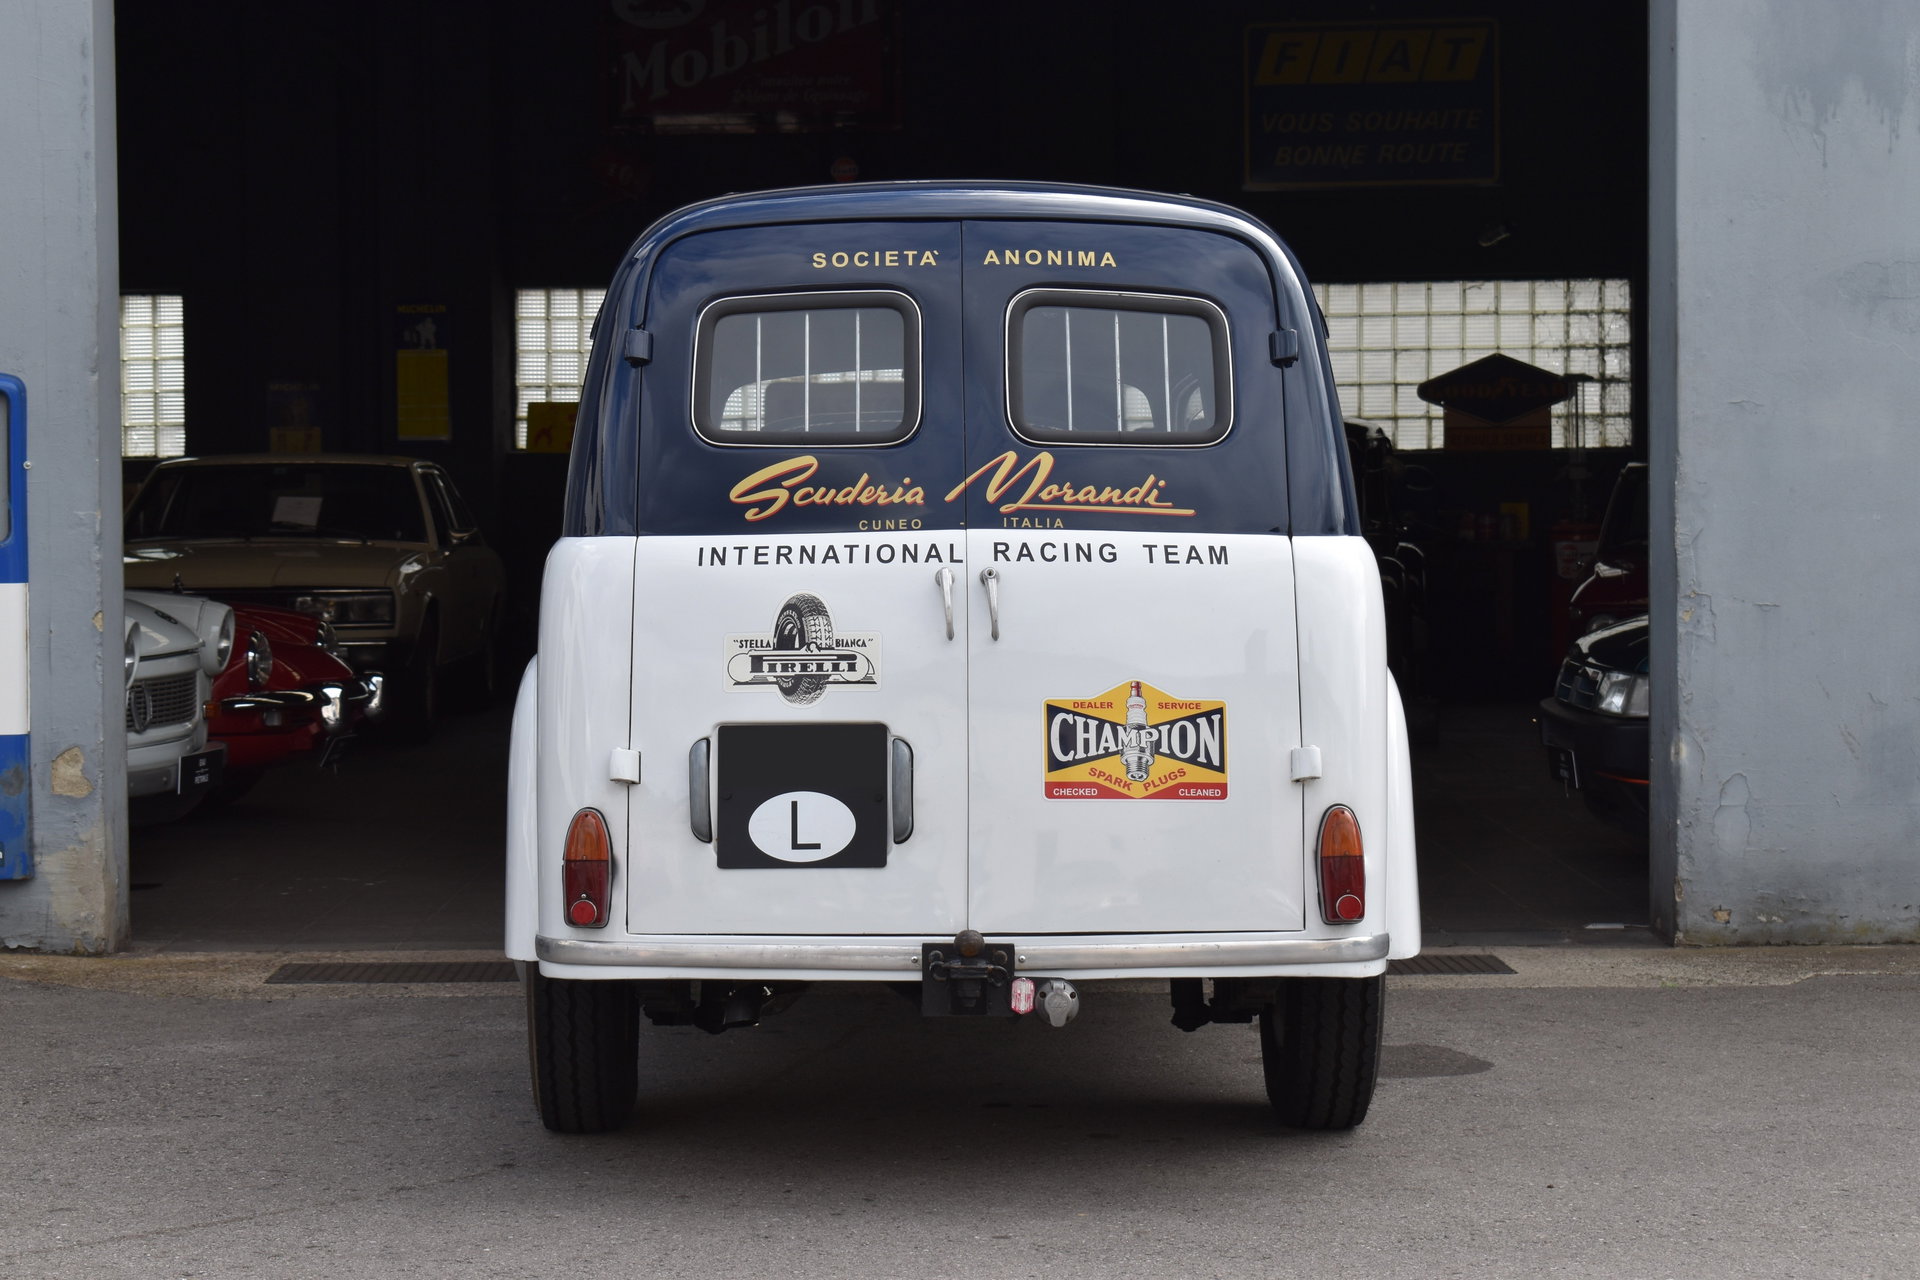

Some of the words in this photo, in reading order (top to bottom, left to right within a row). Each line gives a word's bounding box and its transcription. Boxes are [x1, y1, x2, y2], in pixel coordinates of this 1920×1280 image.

[1270, 35, 1477, 78] FIAT
[1262, 112, 1334, 134] VOUS
[1345, 108, 1483, 133] SOUHAITE
[1273, 145, 1367, 167] BONNE
[1377, 141, 1470, 164] ROUTE
[983, 249, 1118, 268] ANONIMA
[729, 455, 926, 522] Scuderia
[944, 450, 1197, 517] Morandi
[858, 518, 922, 531] CUNEO
[1003, 517, 1065, 529] ITALIA
[697, 543, 964, 567] INTERNATIONAL
[993, 541, 1119, 563] RACING
[1142, 544, 1229, 565] TEAM
[749, 653, 858, 674] PIRELLI
[1072, 701, 1114, 710] DEALER
[1157, 701, 1202, 710] SERVICE
[1050, 712, 1221, 766] CHAMPION
[1053, 788, 1098, 796] CHECKED
[1178, 788, 1221, 797] CLEANED
[1088, 767, 1134, 792] SPARK
[1143, 767, 1187, 792] PLUGS
[791, 801, 821, 850] L
